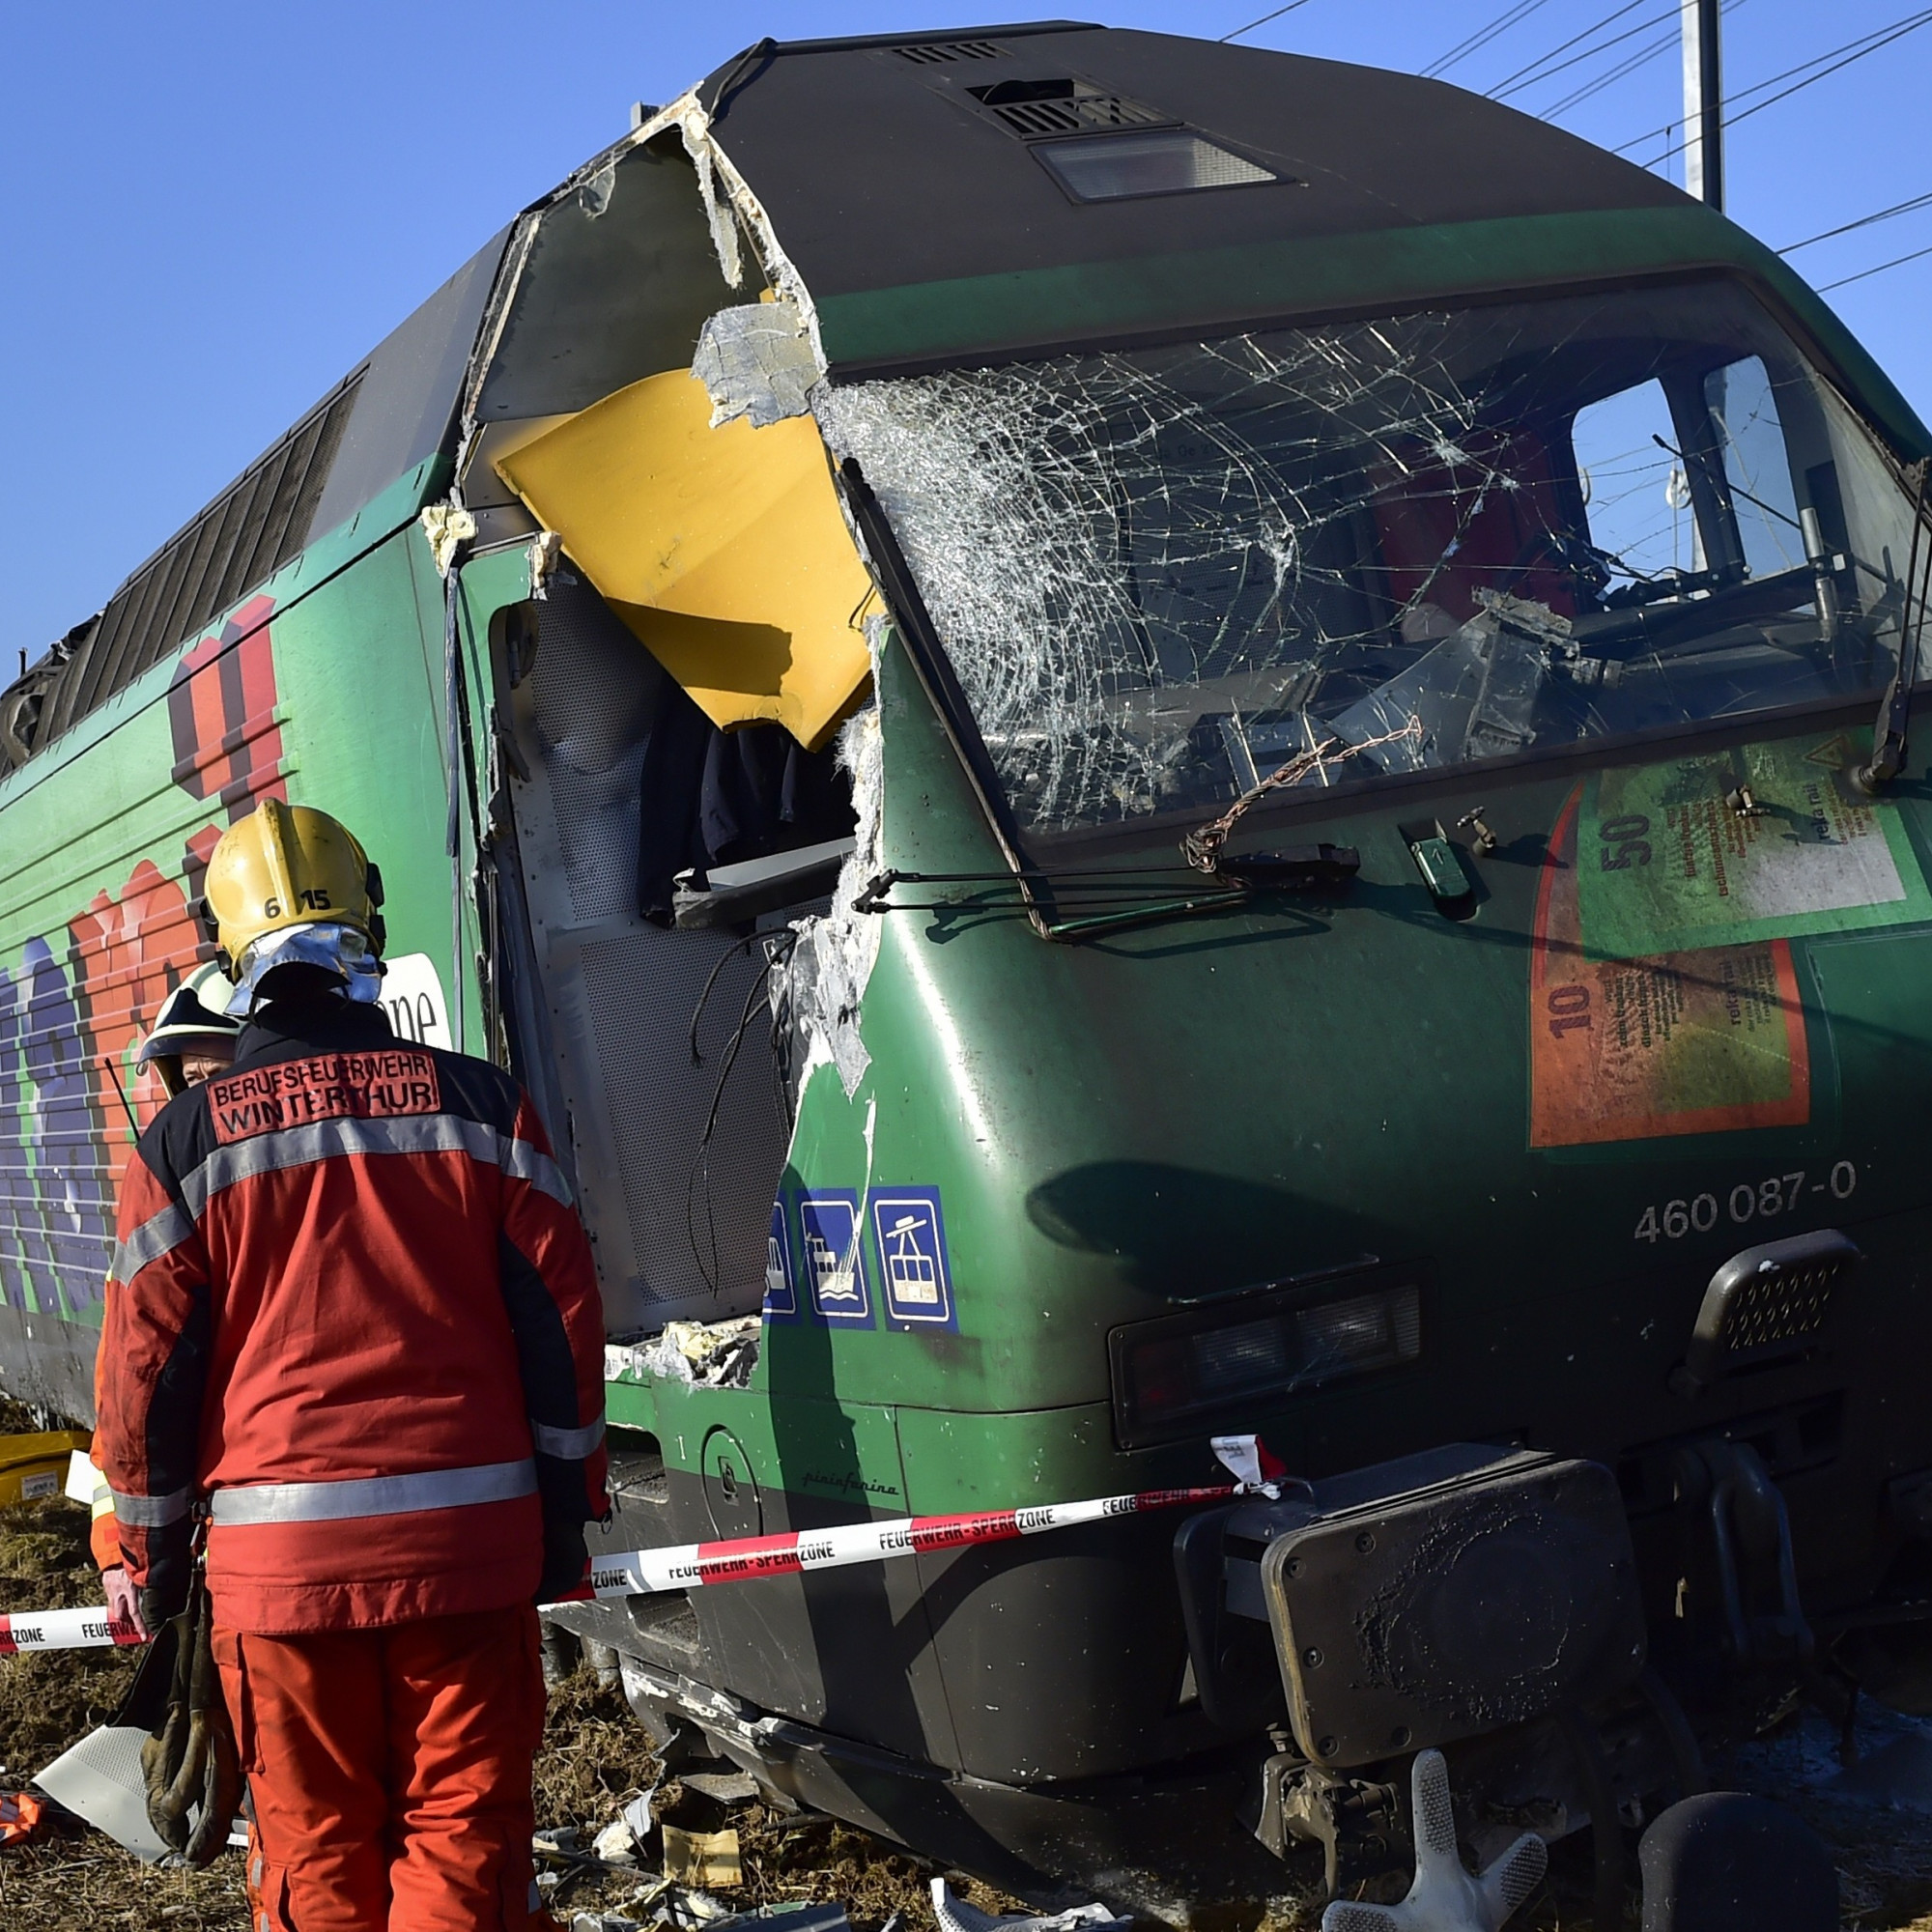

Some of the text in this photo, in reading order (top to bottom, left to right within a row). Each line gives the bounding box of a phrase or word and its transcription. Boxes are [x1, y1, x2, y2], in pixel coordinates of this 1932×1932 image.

[1599, 814, 1652, 872] 50
[264, 889, 331, 920] 6 15
[376, 992, 437, 1045] ne
[1548, 984, 1591, 1039] 10
[1725, 989, 1742, 1025] reka
[213, 1055, 429, 1108] BERUFSFEUERWEHR
[219, 1082, 434, 1135] WINTERTHUR
[1634, 1159, 1858, 1244] 460 087-0
[802, 1470, 900, 1496] pininfarina
[880, 1508, 1056, 1550] FEUERWEHR-SPERRZONE
[668, 1541, 836, 1580] FEUERWEHR-SPERRZONE
